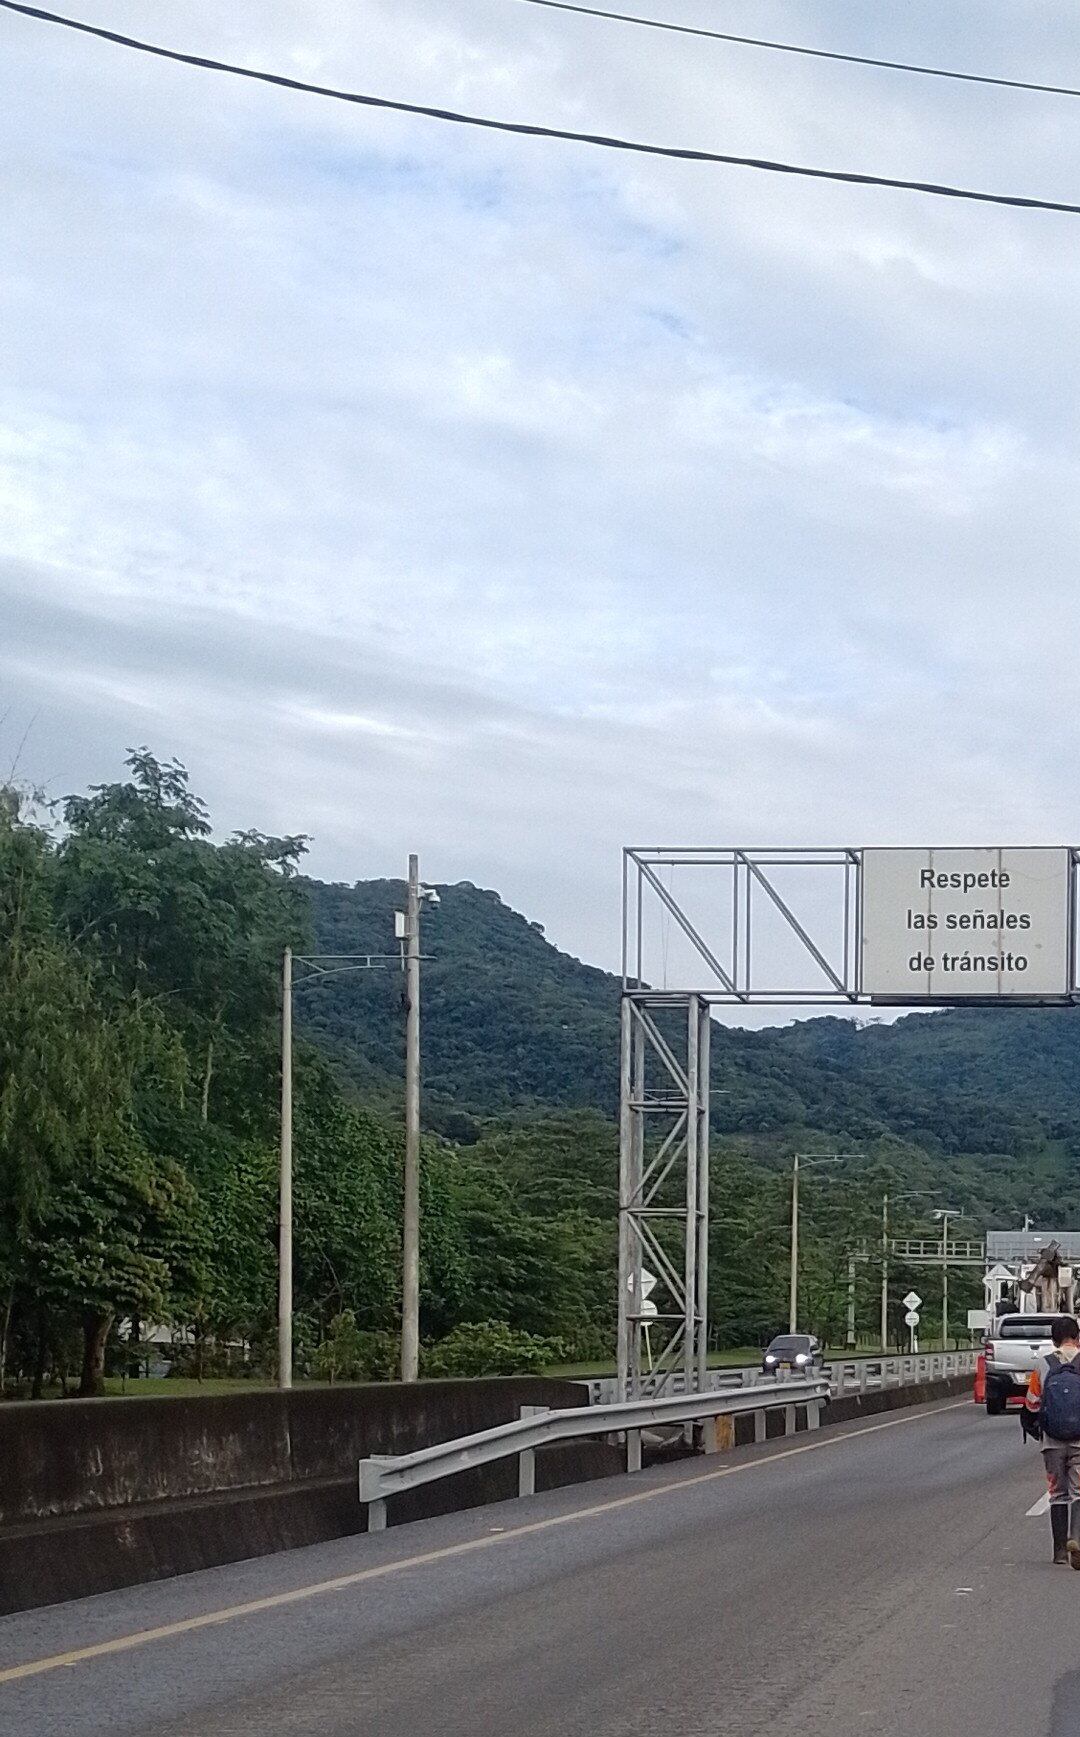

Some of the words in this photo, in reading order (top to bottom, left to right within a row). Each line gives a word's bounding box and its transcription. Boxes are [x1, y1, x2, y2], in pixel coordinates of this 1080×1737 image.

[920, 868, 1010, 894] Respete
[907, 909, 938, 930] las
[945, 909, 1031, 930] señales
[909, 951, 935, 972] de
[941, 949, 1028, 972] tránsito
